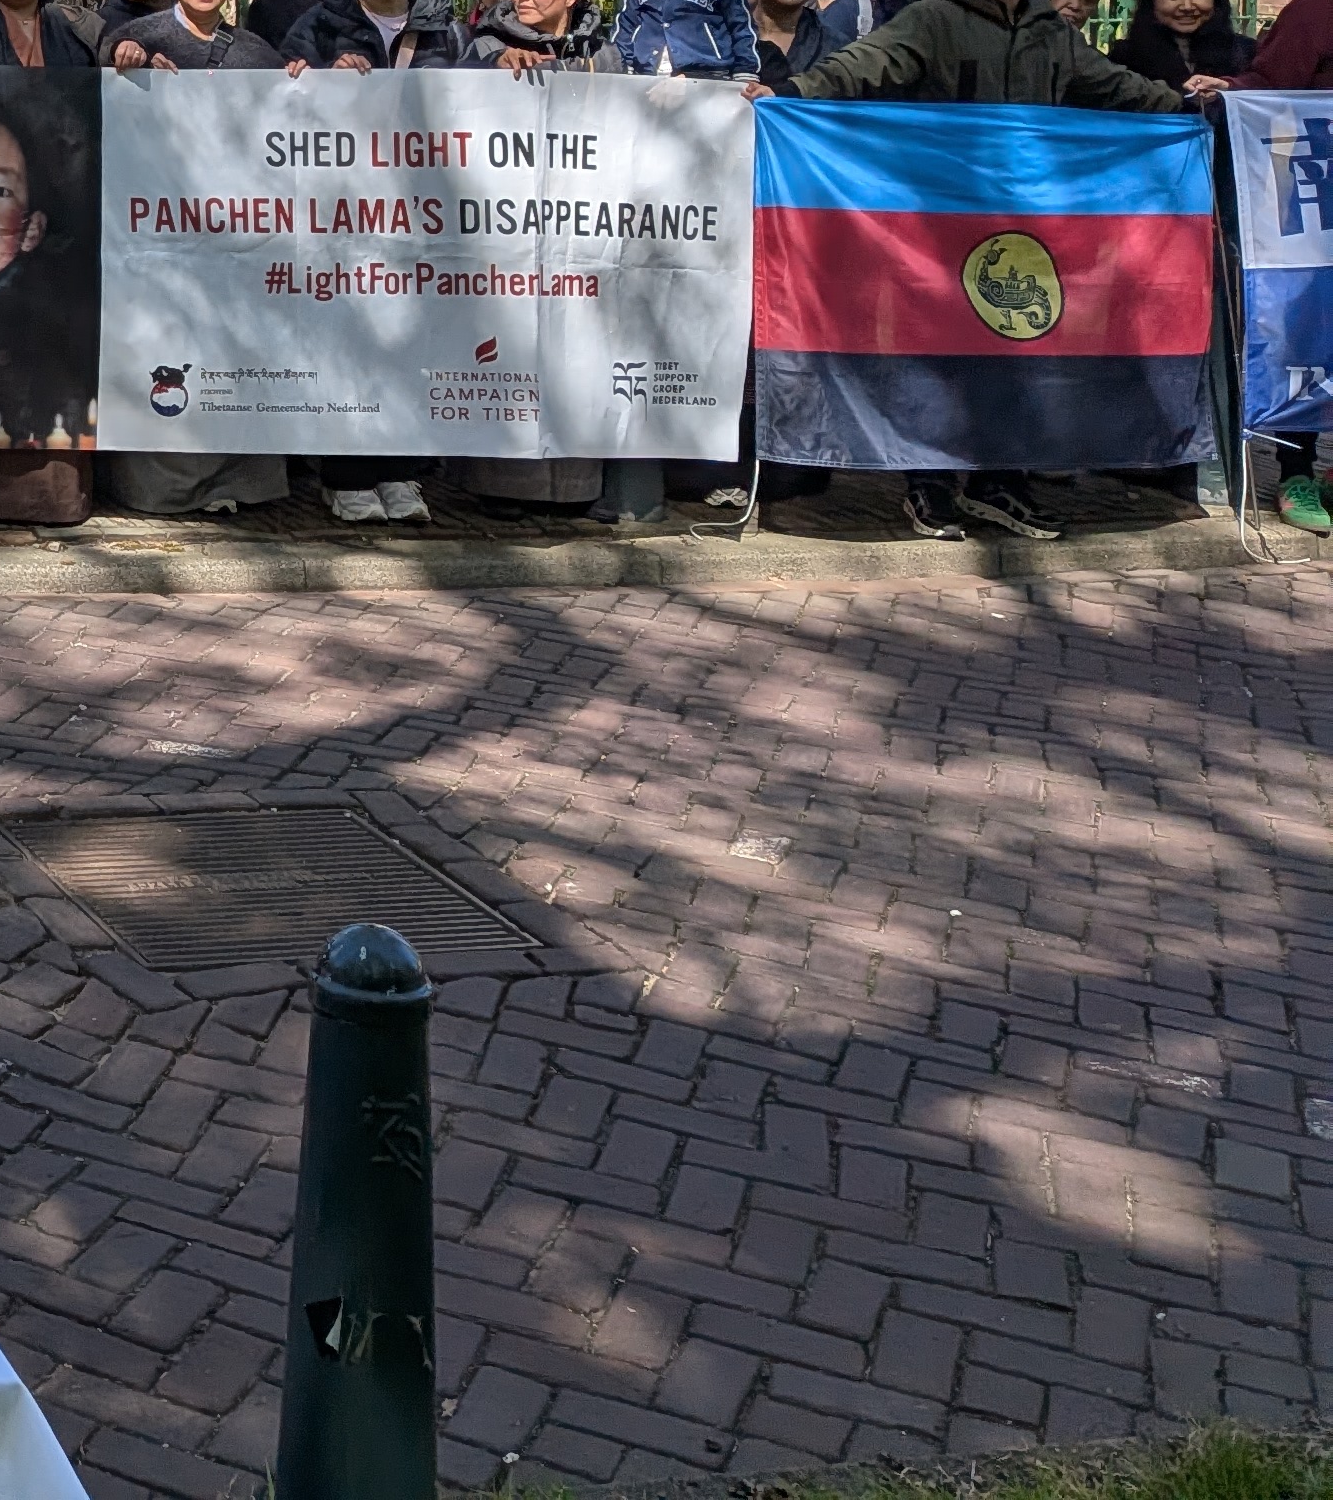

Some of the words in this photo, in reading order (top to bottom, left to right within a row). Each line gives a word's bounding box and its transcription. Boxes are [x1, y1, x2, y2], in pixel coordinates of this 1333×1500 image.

[265, 131, 355, 168] SHED
[370, 131, 472, 168] LIGHT
[488, 132, 533, 168] ON
[545, 132, 597, 170] THE
[130, 197, 295, 234] PANCHEN
[309, 196, 444, 235] LAMA'S
[459, 198, 718, 242] DISAPPEARANCE
[654, 362, 679, 371] TIBET
[429, 371, 539, 383] INTERNATIONAL
[653, 373, 698, 383] SUPPORT
[429, 387, 540, 402] CAMPAIGN
[653, 384, 685, 393] GROEP
[652, 396, 716, 406] NEDERLAND
[200, 402, 252, 412] Tibetaanse
[256, 402, 324, 414] Gemeenschap
[327, 403, 380, 413] Nederland
[430, 406, 469, 421] FOR
[484, 407, 540, 422] TIBET
